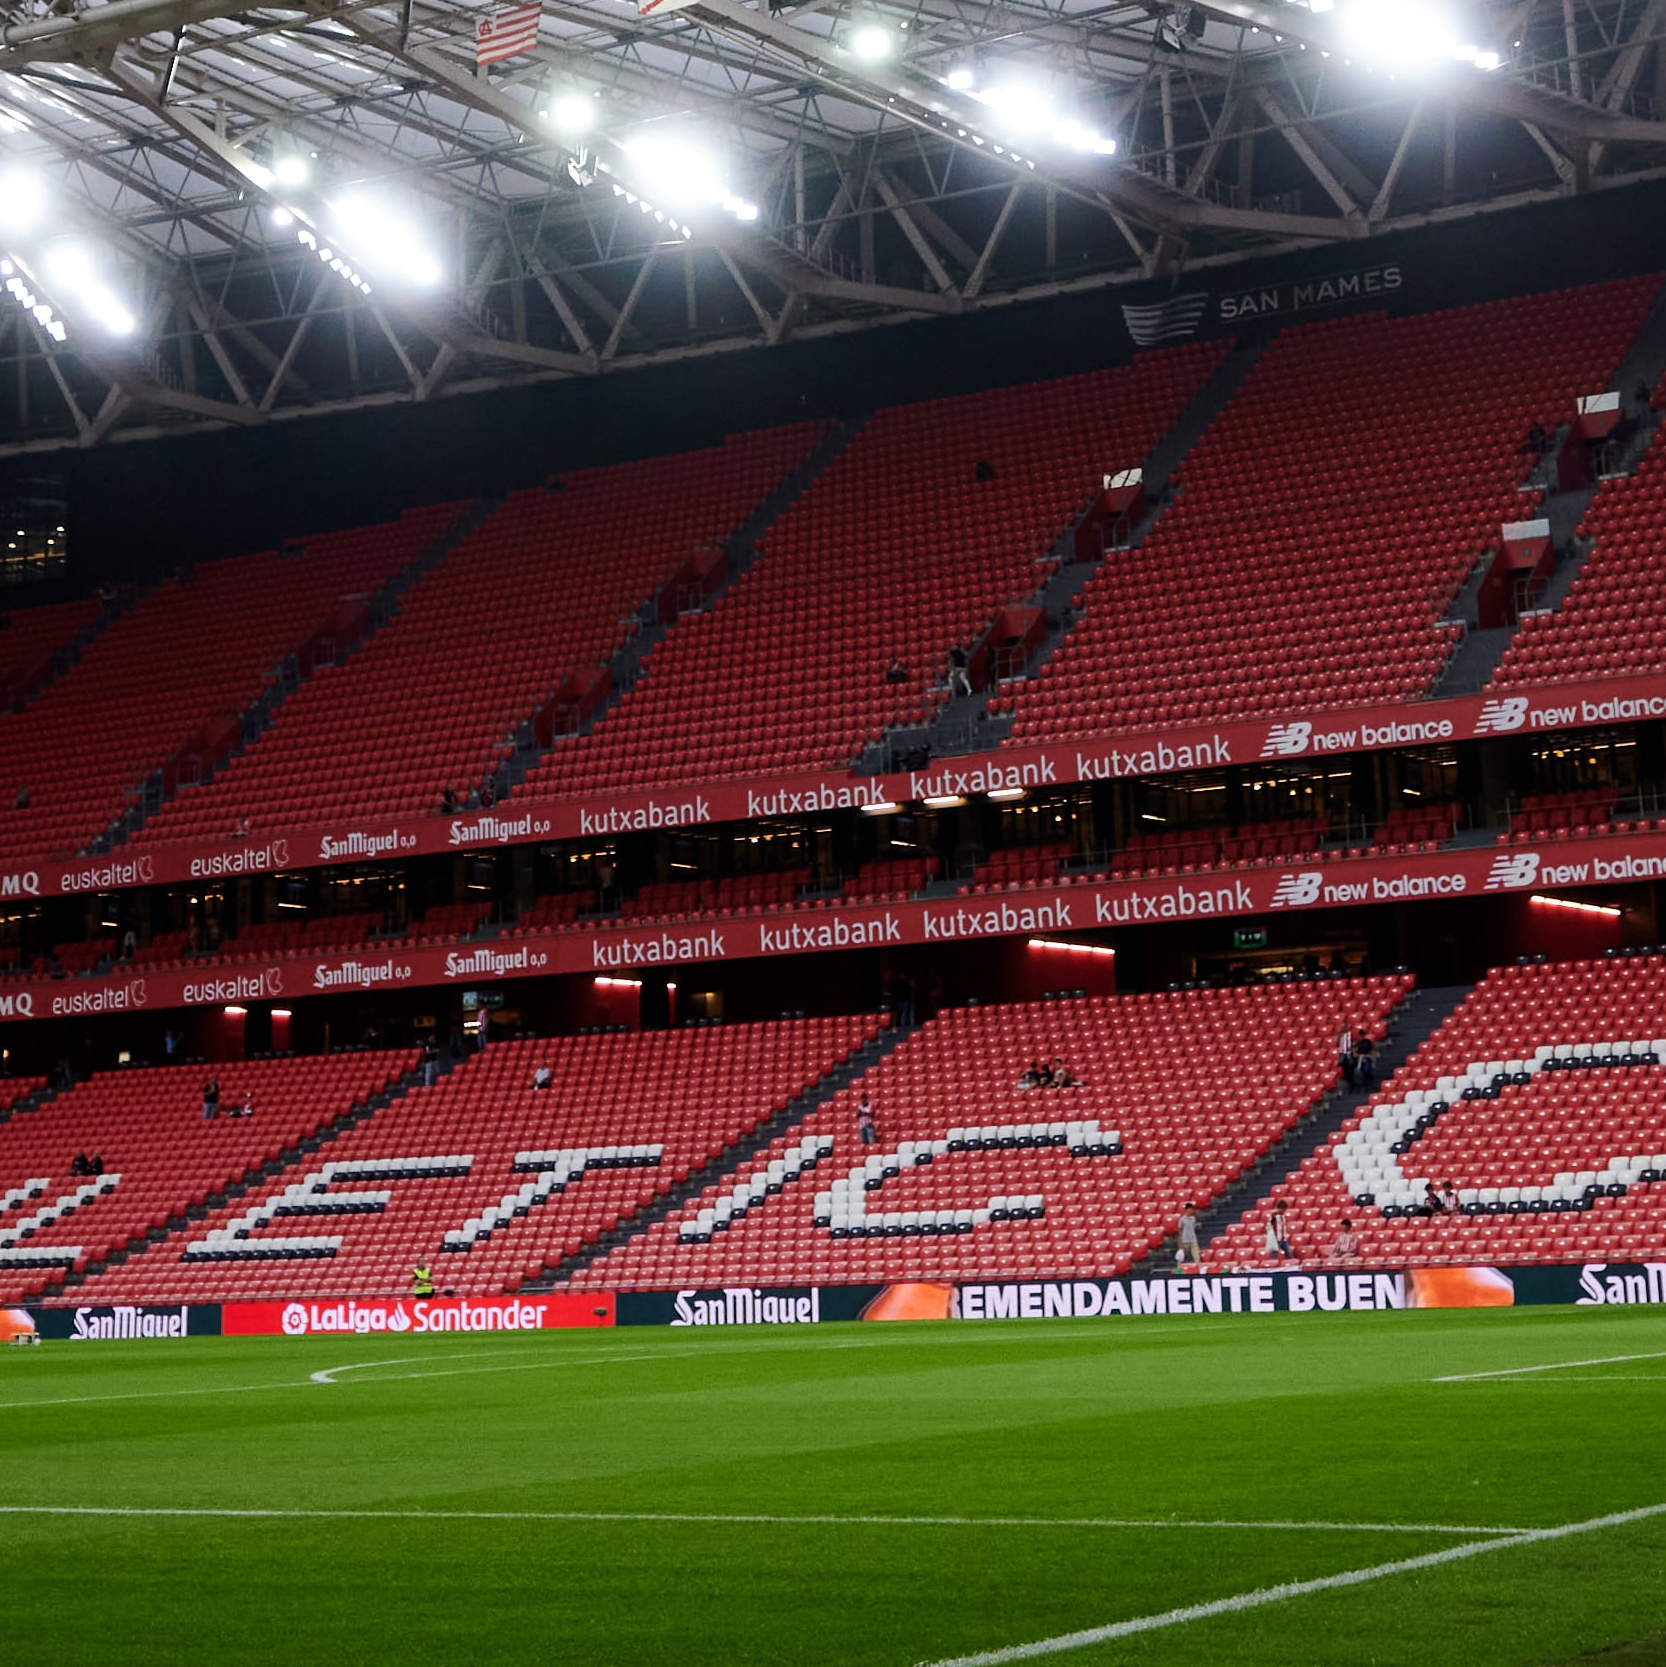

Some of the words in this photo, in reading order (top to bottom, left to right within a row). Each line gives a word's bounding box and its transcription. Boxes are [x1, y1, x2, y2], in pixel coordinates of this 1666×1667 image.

[1221, 291, 1278, 318] SAN
[1294, 268, 1402, 310] MAMES
[1314, 731, 1357, 750] new
[1362, 720, 1453, 745] balance
[1530, 707, 1576, 727] new
[1076, 733, 1231, 782] kutxabank
[910, 754, 1057, 800] kutxabank
[579, 795, 711, 835] kutxabank
[747, 778, 885, 817] kutxabank
[61, 861, 136, 891] euskaltel
[191, 846, 270, 876] euskaltel
[1542, 864, 1588, 884] new
[1095, 879, 1254, 923] kutxabank
[1324, 883, 1368, 902] new
[1373, 874, 1466, 898] balance
[759, 913, 901, 952] kutxabank
[923, 898, 1072, 939] kutxabank
[592, 929, 726, 968] kutxabank
[53, 986, 128, 1014] euskaltel
[184, 974, 263, 1002] euskaltel
[1288, 1275, 1405, 1311] BUEN
[311, 1301, 391, 1333] LaLiga
[413, 1300, 547, 1332] Santander
